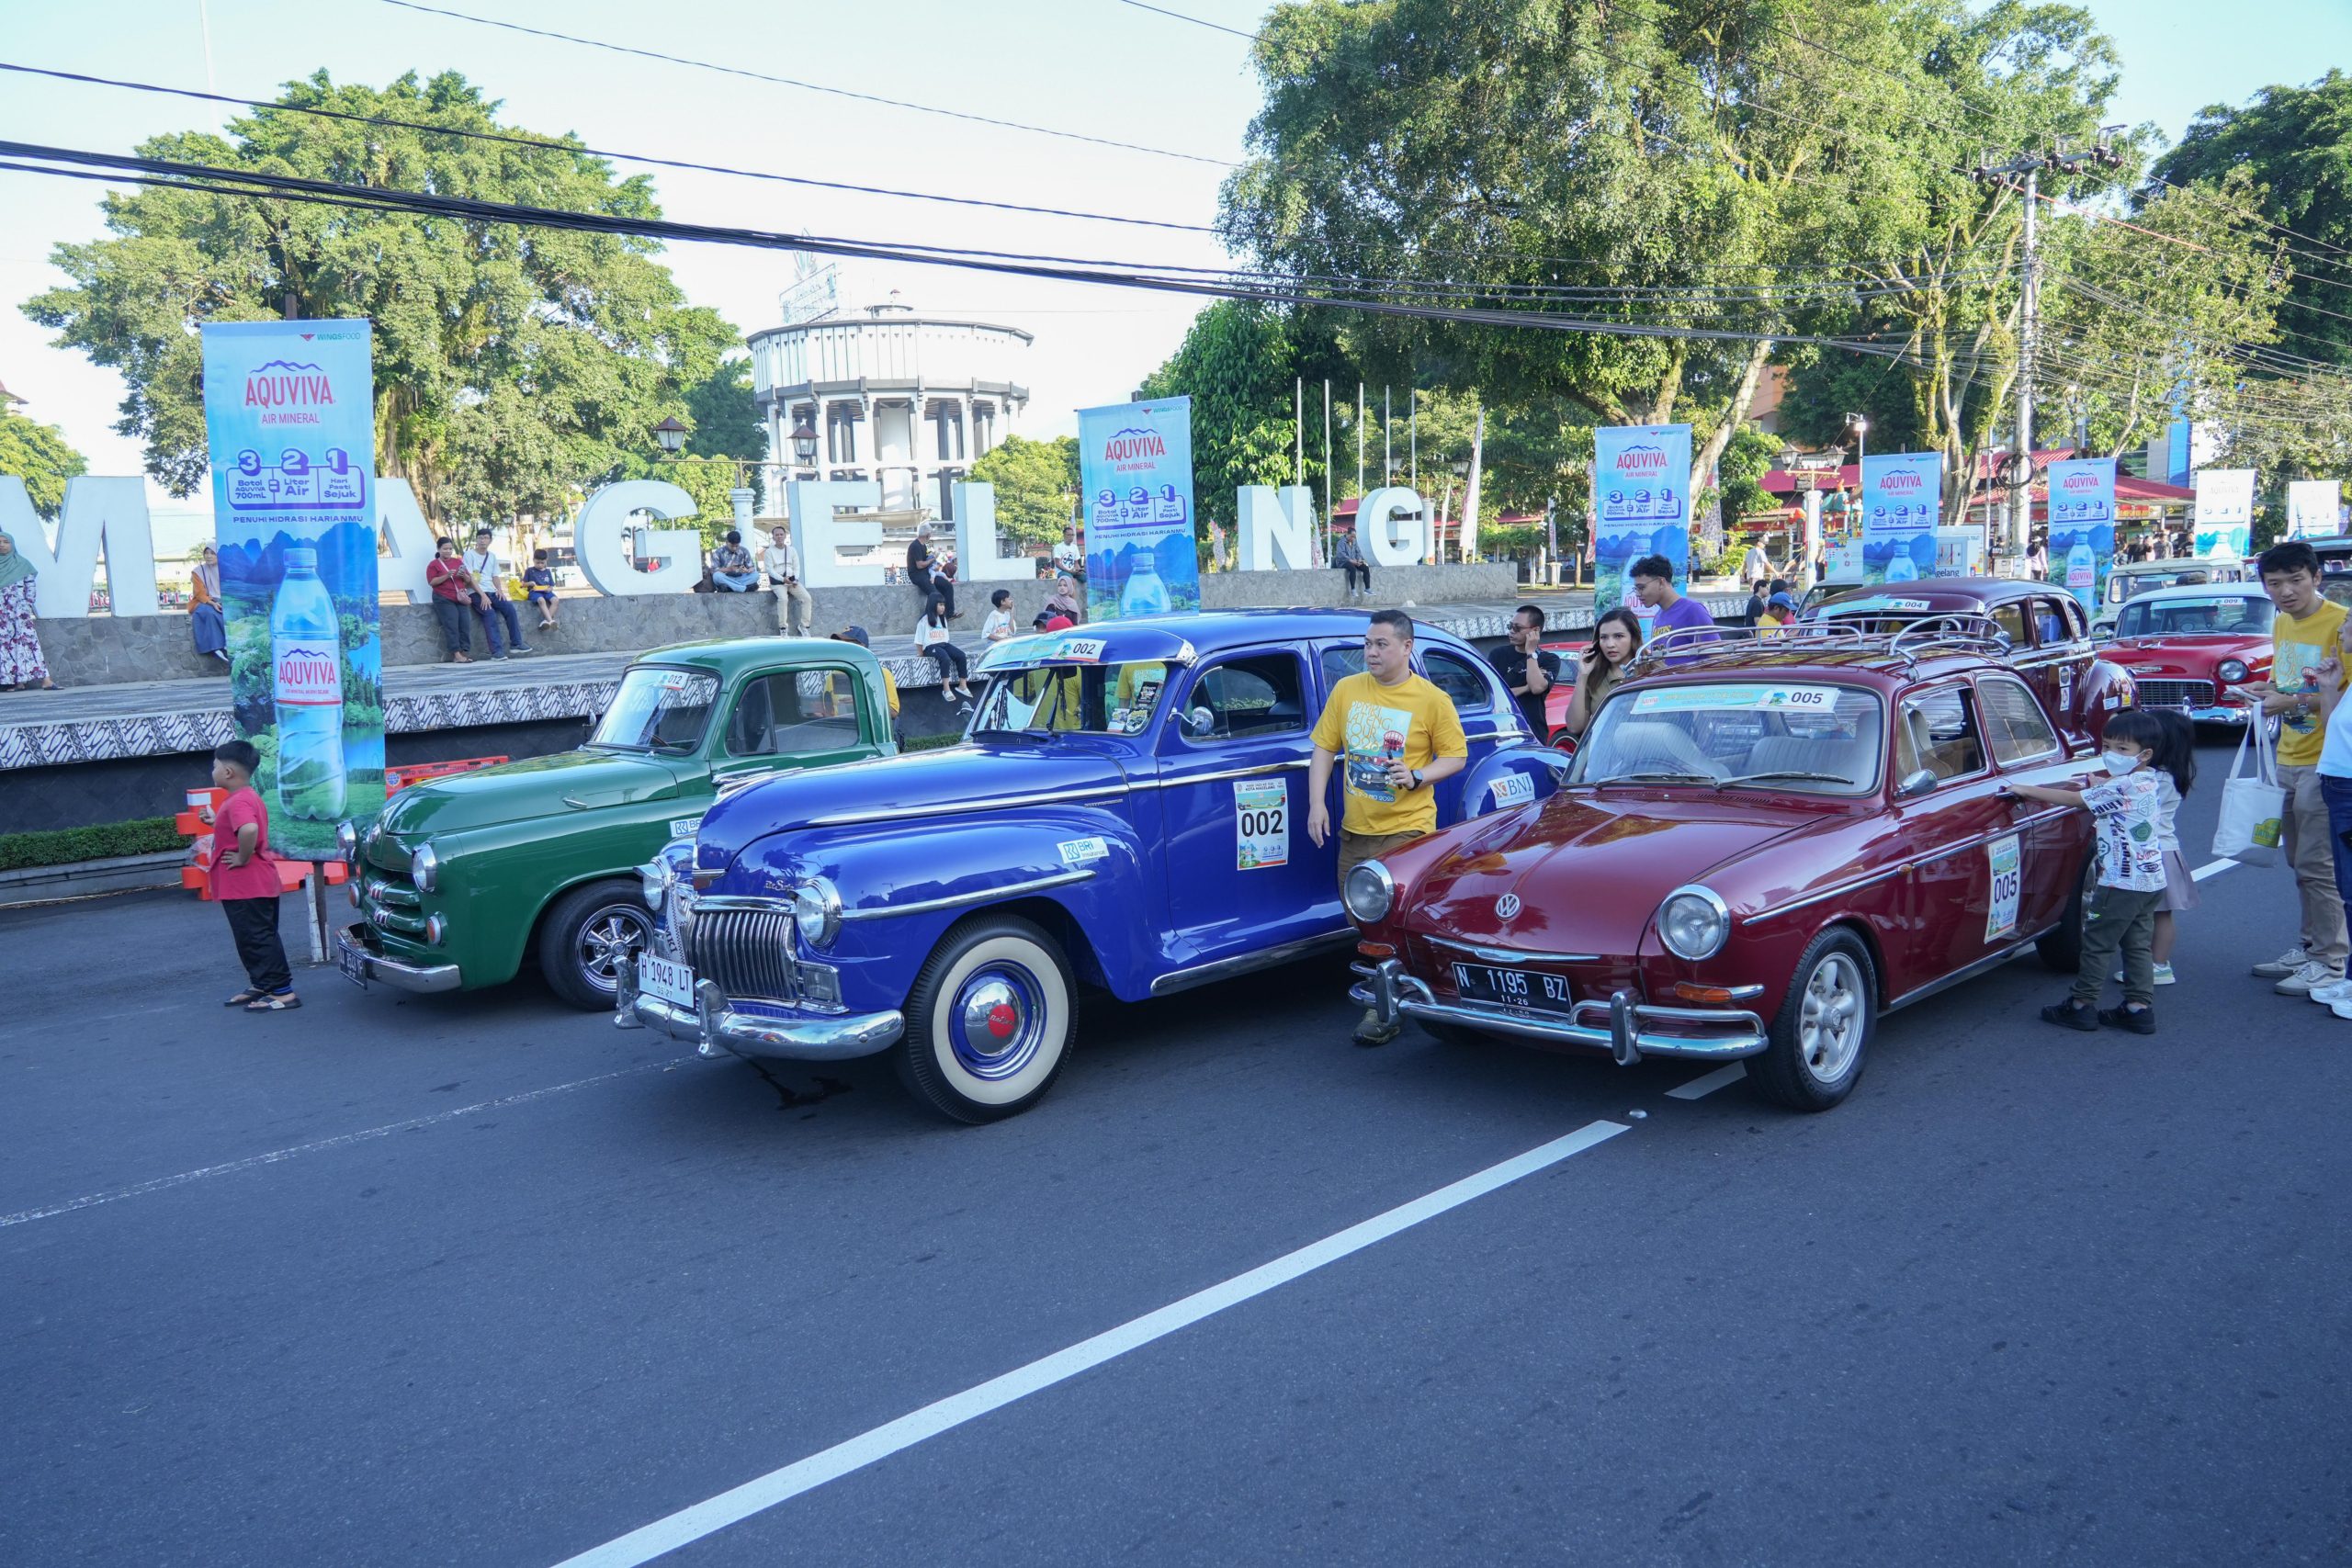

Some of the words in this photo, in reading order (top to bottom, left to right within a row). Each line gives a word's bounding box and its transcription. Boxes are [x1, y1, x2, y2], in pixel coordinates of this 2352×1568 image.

[245, 375, 334, 409] AQUVIVA
[262, 414, 276, 424] AIR
[279, 413, 320, 423] MINERAL
[1105, 435, 1166, 461] AQUVIVA
[238, 449, 258, 473] 3
[281, 448, 306, 473] 2
[326, 448, 345, 473] 1
[1116, 464, 1126, 472] AIR
[1128, 461, 1156, 471] MINERAL
[1617, 452, 1668, 469] AQUVIVA
[1880, 475, 1922, 490] AQUVIVA
[2063, 477, 2099, 489] AQUVIVA
[285, 486, 310, 496] Air
[324, 491, 356, 499] Sejuk
[1099, 490, 1114, 507] 3
[1129, 487, 1147, 504] 2
[1160, 484, 1174, 501] 1
[1610, 491, 1623, 503] 3
[1635, 490, 1650, 502] 2
[1660, 489, 1672, 502] 1
[1875, 506, 1885, 516] 3
[1895, 505, 1907, 515] 2
[1917, 504, 1927, 514] 1
[1073, 643, 1096, 655] 002
[279, 661, 336, 687] AQUVIVA
[668, 674, 683, 684] 012
[1792, 692, 1823, 704] 005
[1507, 775, 1532, 795] BNI
[1242, 809, 1283, 837] 002
[1077, 840, 1094, 852] BRI
[1994, 871, 2017, 904] 005
[641, 958, 647, 978] H
[651, 961, 673, 987] 1948
[679, 968, 690, 992] LT
[1456, 965, 1470, 988] N
[1487, 969, 1528, 995] 1195
[1544, 976, 1567, 1002] BZ
